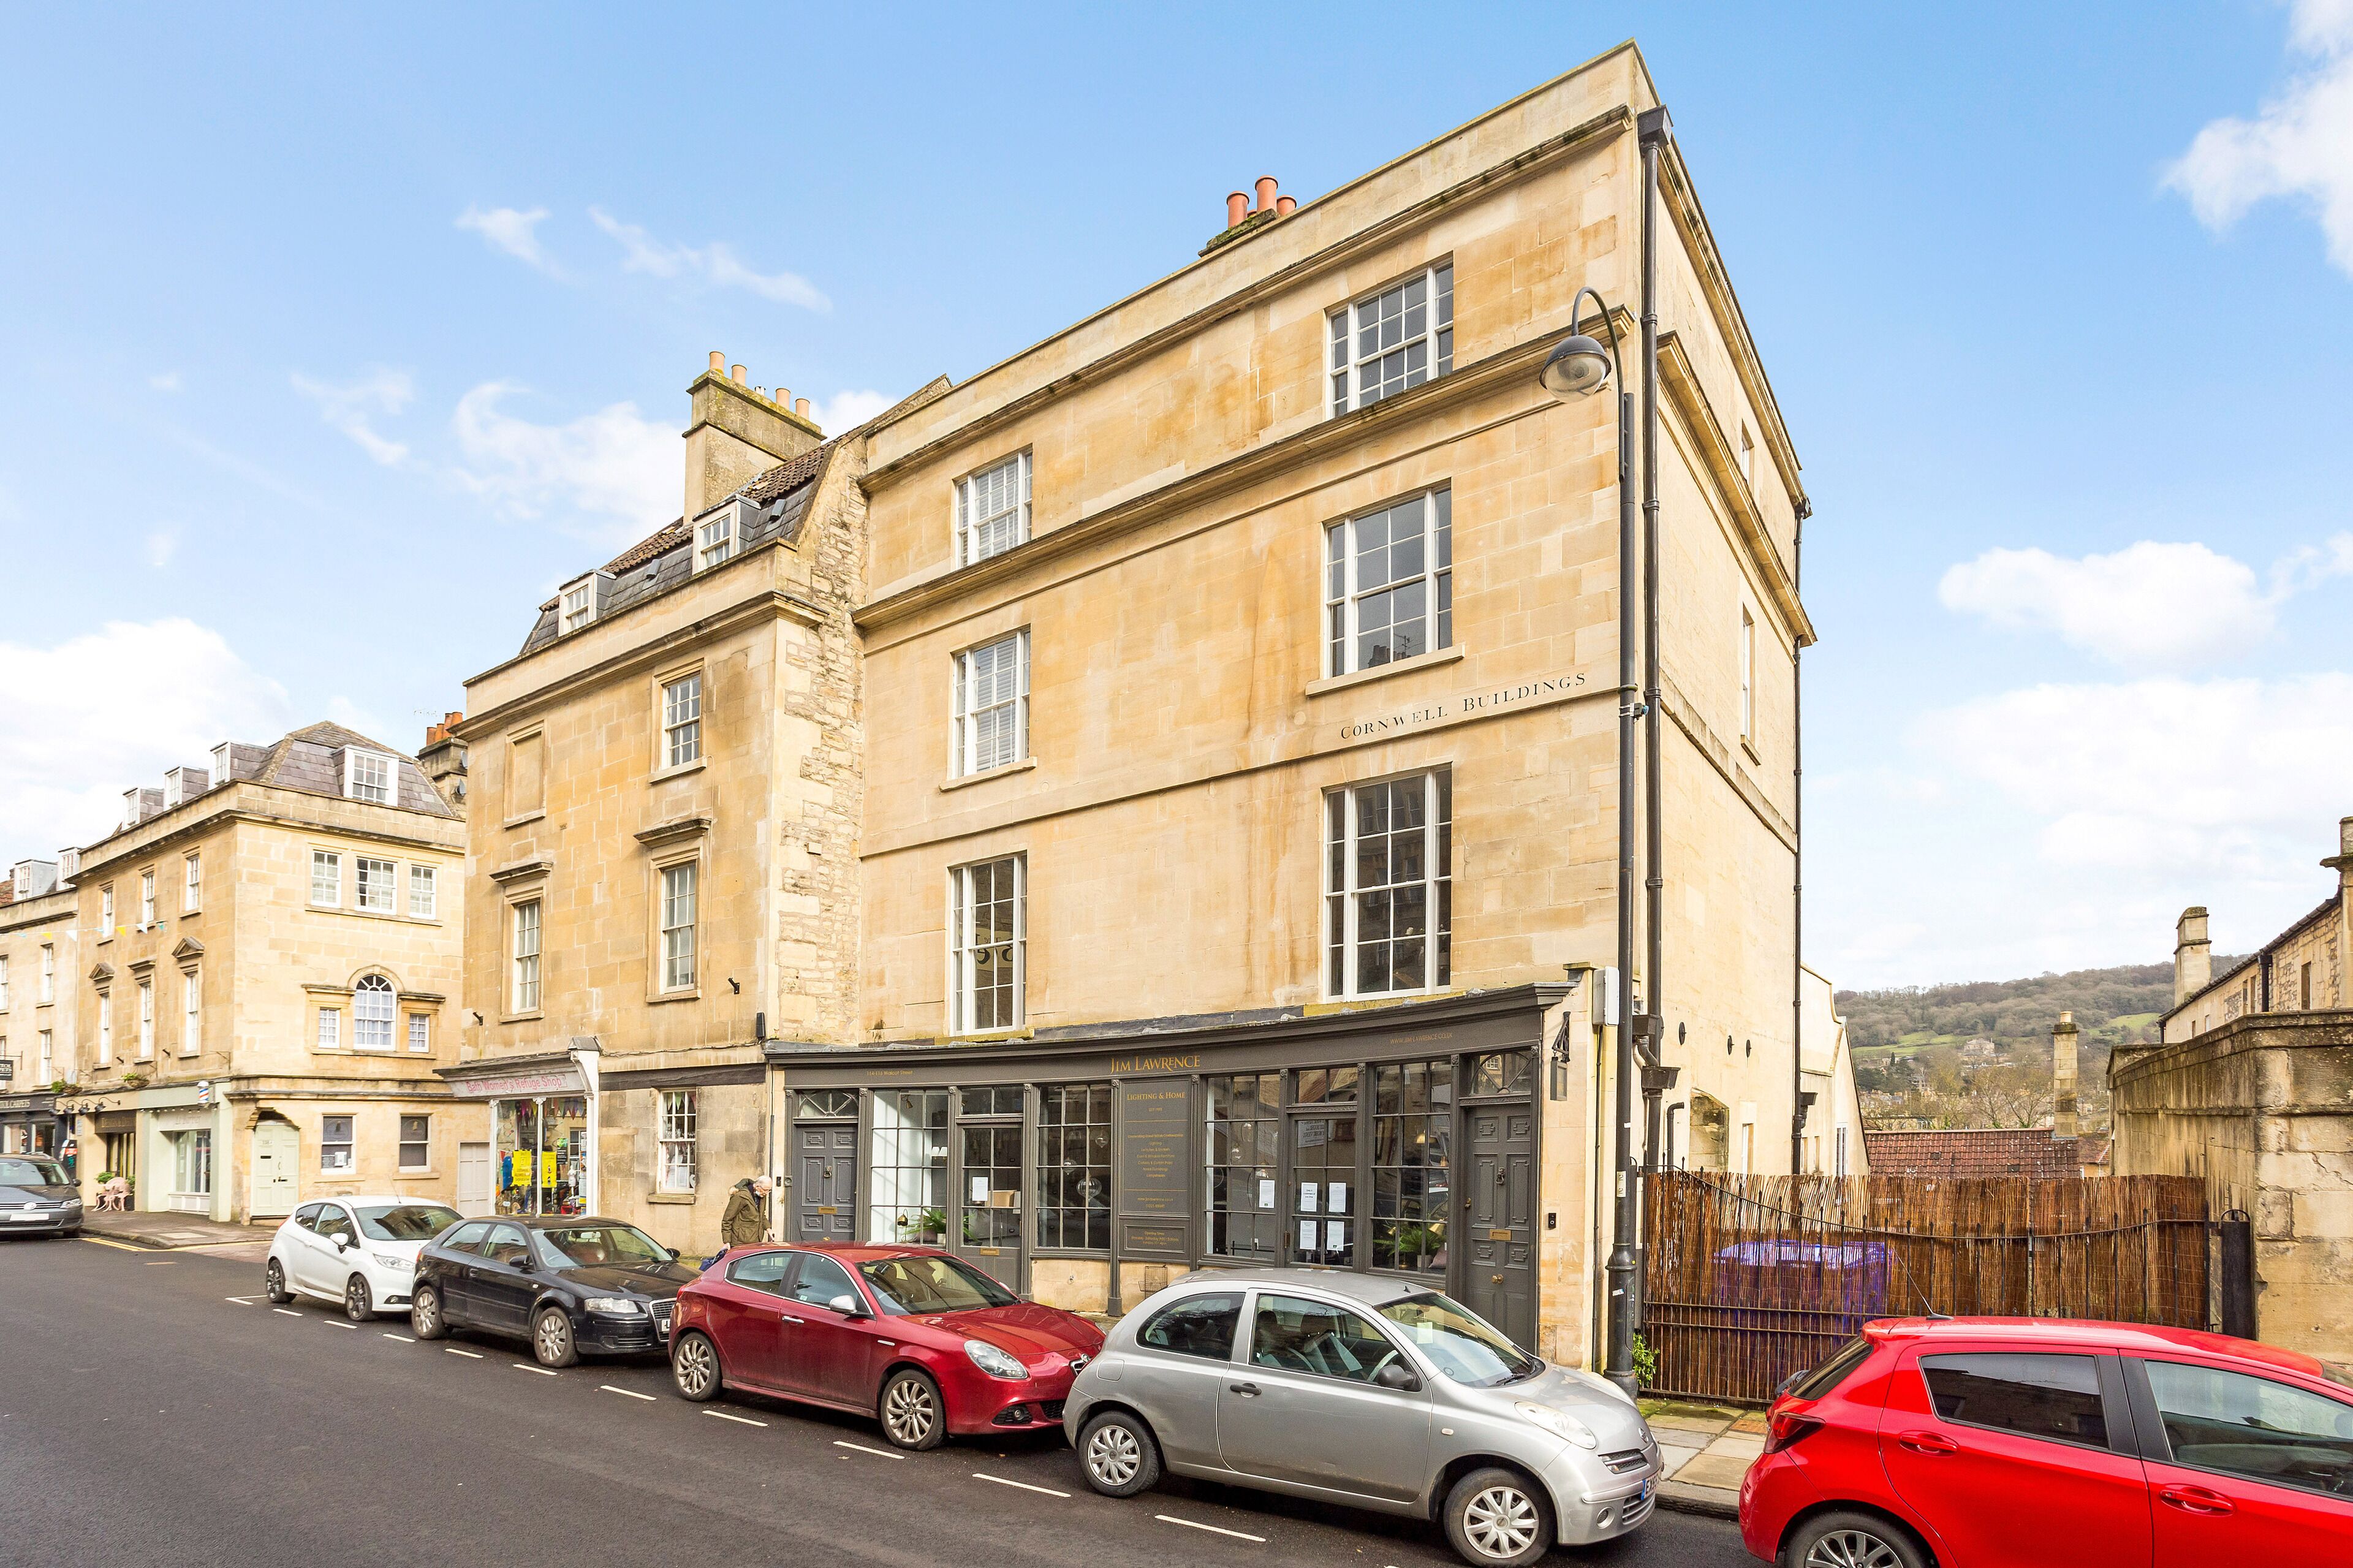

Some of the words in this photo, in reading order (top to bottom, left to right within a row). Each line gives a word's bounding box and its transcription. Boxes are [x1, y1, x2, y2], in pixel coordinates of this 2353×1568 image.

[1341, 706, 1448, 740] CORNWELL
[1463, 672, 1586, 712] BUILDINGS
[1110, 1058, 1131, 1074] JIM
[1135, 1055, 1200, 1071] LAWRENCE
[466, 1081, 482, 1093] Bath
[482, 1078, 515, 1091] Women's
[515, 1077, 541, 1090] Refuge
[540, 1076, 562, 1089] Shop
